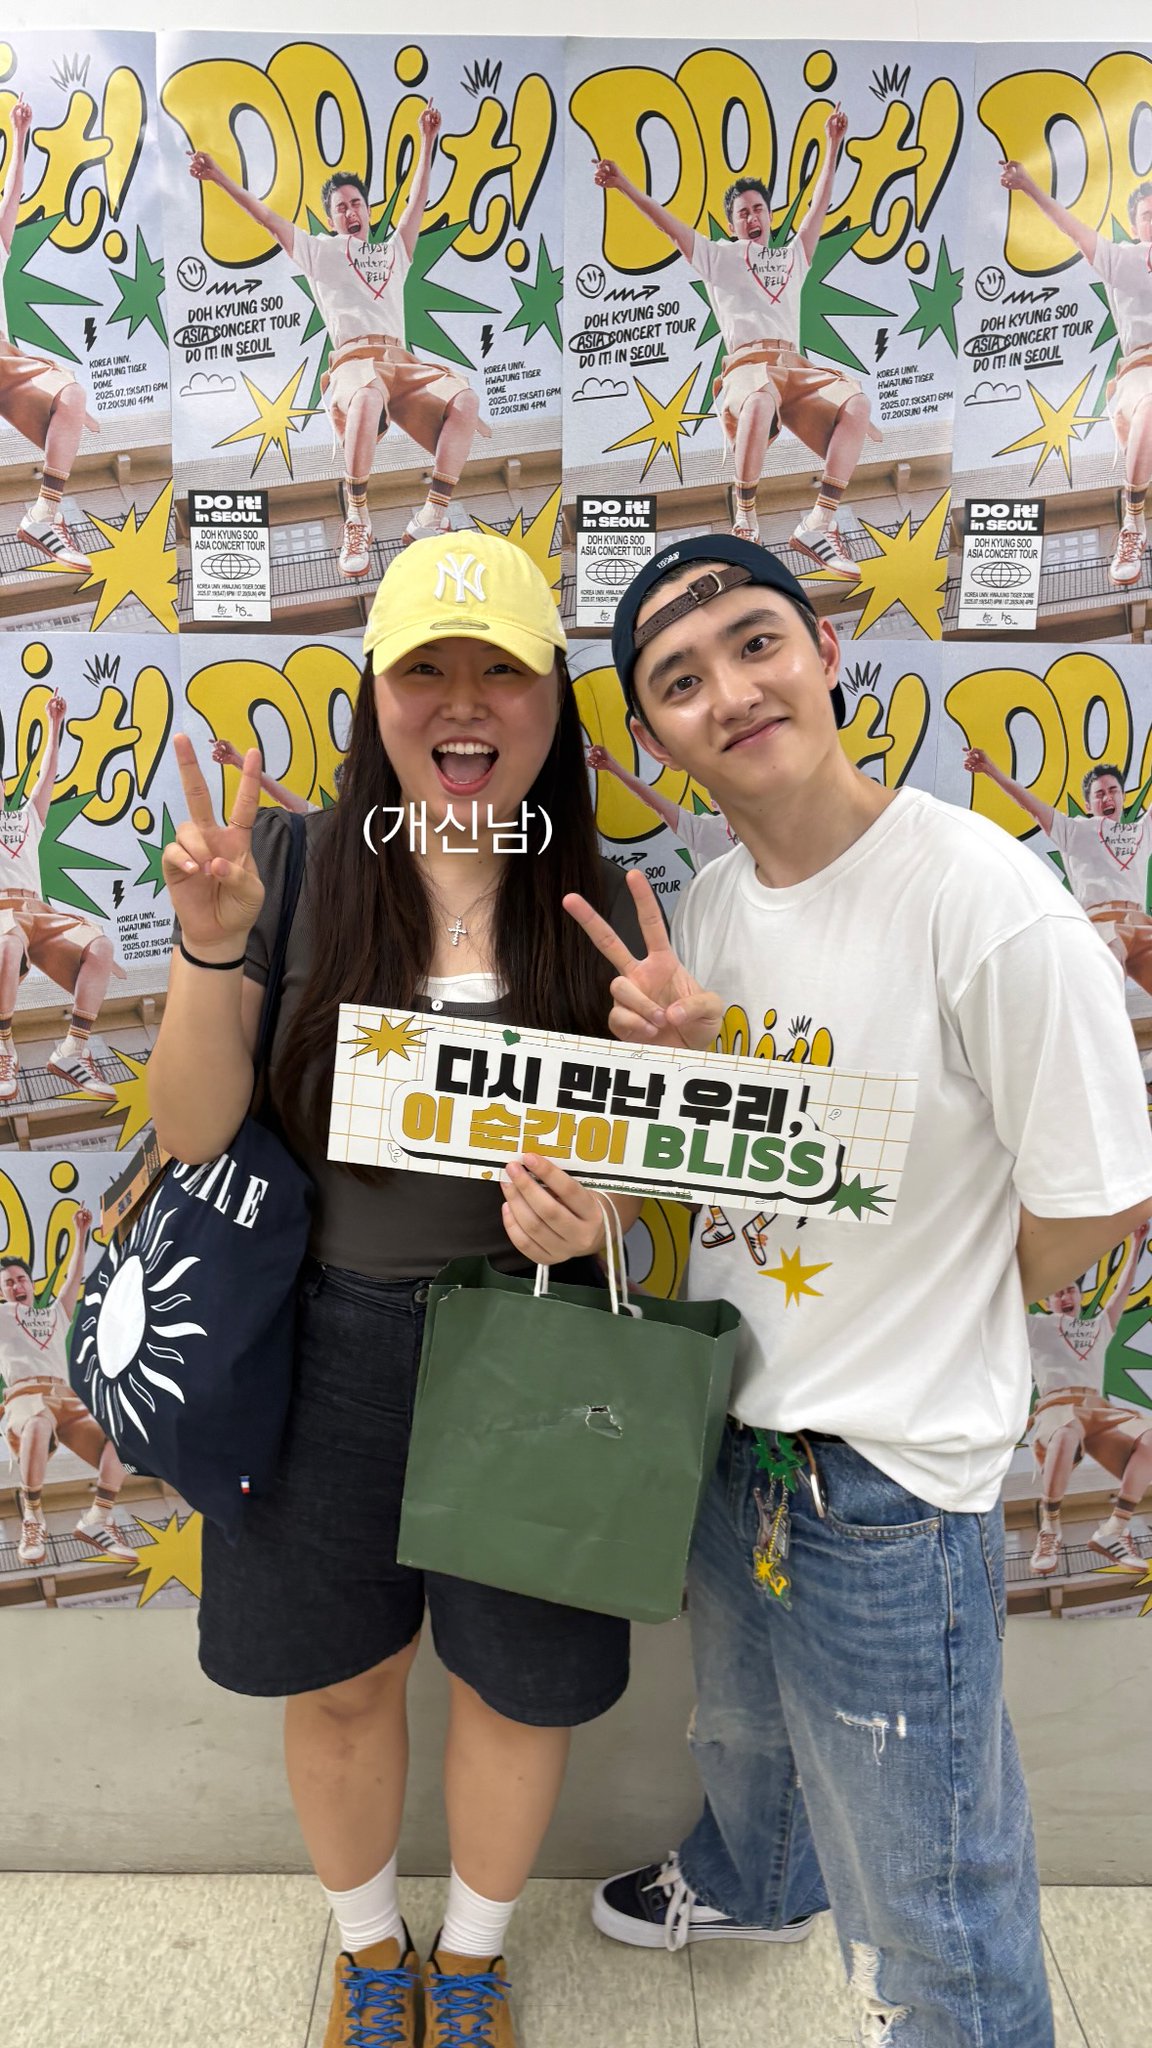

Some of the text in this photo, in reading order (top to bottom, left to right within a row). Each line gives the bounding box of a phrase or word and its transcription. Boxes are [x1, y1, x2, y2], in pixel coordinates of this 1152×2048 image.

[188, 295, 284, 323] DOH KYUNG SOO
[584, 300, 680, 330] DOH KYUNG SOO
[980, 302, 1078, 333] DOH KYUNG SOO
[182, 312, 301, 345] ASIA CONCERT TOUR
[577, 317, 697, 350] ASIA CONCERT TOUR
[972, 319, 1094, 354] ASIA CONCERT TOUR
[185, 348, 201, 364] DO
[221, 343, 233, 358] IN
[236, 337, 272, 356] SEOUL
[579, 353, 595, 369] DO
[614, 348, 627, 363] IN
[630, 342, 667, 360] SEOUL
[89, 357, 112, 369] KOREA
[973, 357, 989, 373] DO
[1009, 352, 1022, 367] IN
[1024, 345, 1062, 364] SEOUL
[91, 363, 147, 380] HWAJUNG TIGER
[483, 363, 507, 375] KOREA
[876, 367, 900, 379] KOREA
[485, 368, 542, 386] HWAJUNG TIGER
[877, 372, 935, 390] HWAJUNG TIGER
[93, 379, 113, 390] DOME
[152, 381, 168, 392] 6PM
[486, 385, 507, 396] DOME
[545, 386, 562, 397] 6PM
[878, 389, 899, 400] DOME
[937, 391, 954, 401] 6PM
[137, 395, 154, 405] 4PM
[530, 400, 547, 410] 4PM
[922, 404, 939, 414] 4PM
[194, 494, 262, 510] DO it!
[582, 500, 651, 515] DO it!
[970, 503, 1039, 518] DO it!
[195, 511, 263, 523] in SEOUL
[582, 516, 650, 528] in SEOUL
[970, 519, 1038, 531] in SEOUL
[201, 529, 259, 540] DOH KYUNG SOO
[587, 535, 645, 545] DOH KYUNG SOO
[194, 540, 266, 551] ASIA CONCERT TOUR
[974, 538, 1032, 548] DOH KYUNG SOO
[580, 546, 652, 556] ASIA CONCERT TOUR
[967, 549, 1038, 559] ASIA CONCERT TOUR
[433, 551, 487, 603] NY
[645, 866, 666, 880] SOO
[116, 913, 138, 924] KOREA
[118, 918, 171, 933] HWAJUNG TIGER
[120, 932, 138, 942] DOME
[435, 1043, 803, 1138] 다시 만난 우리,
[402, 1091, 826, 1187] 이 순간이 BLISS
